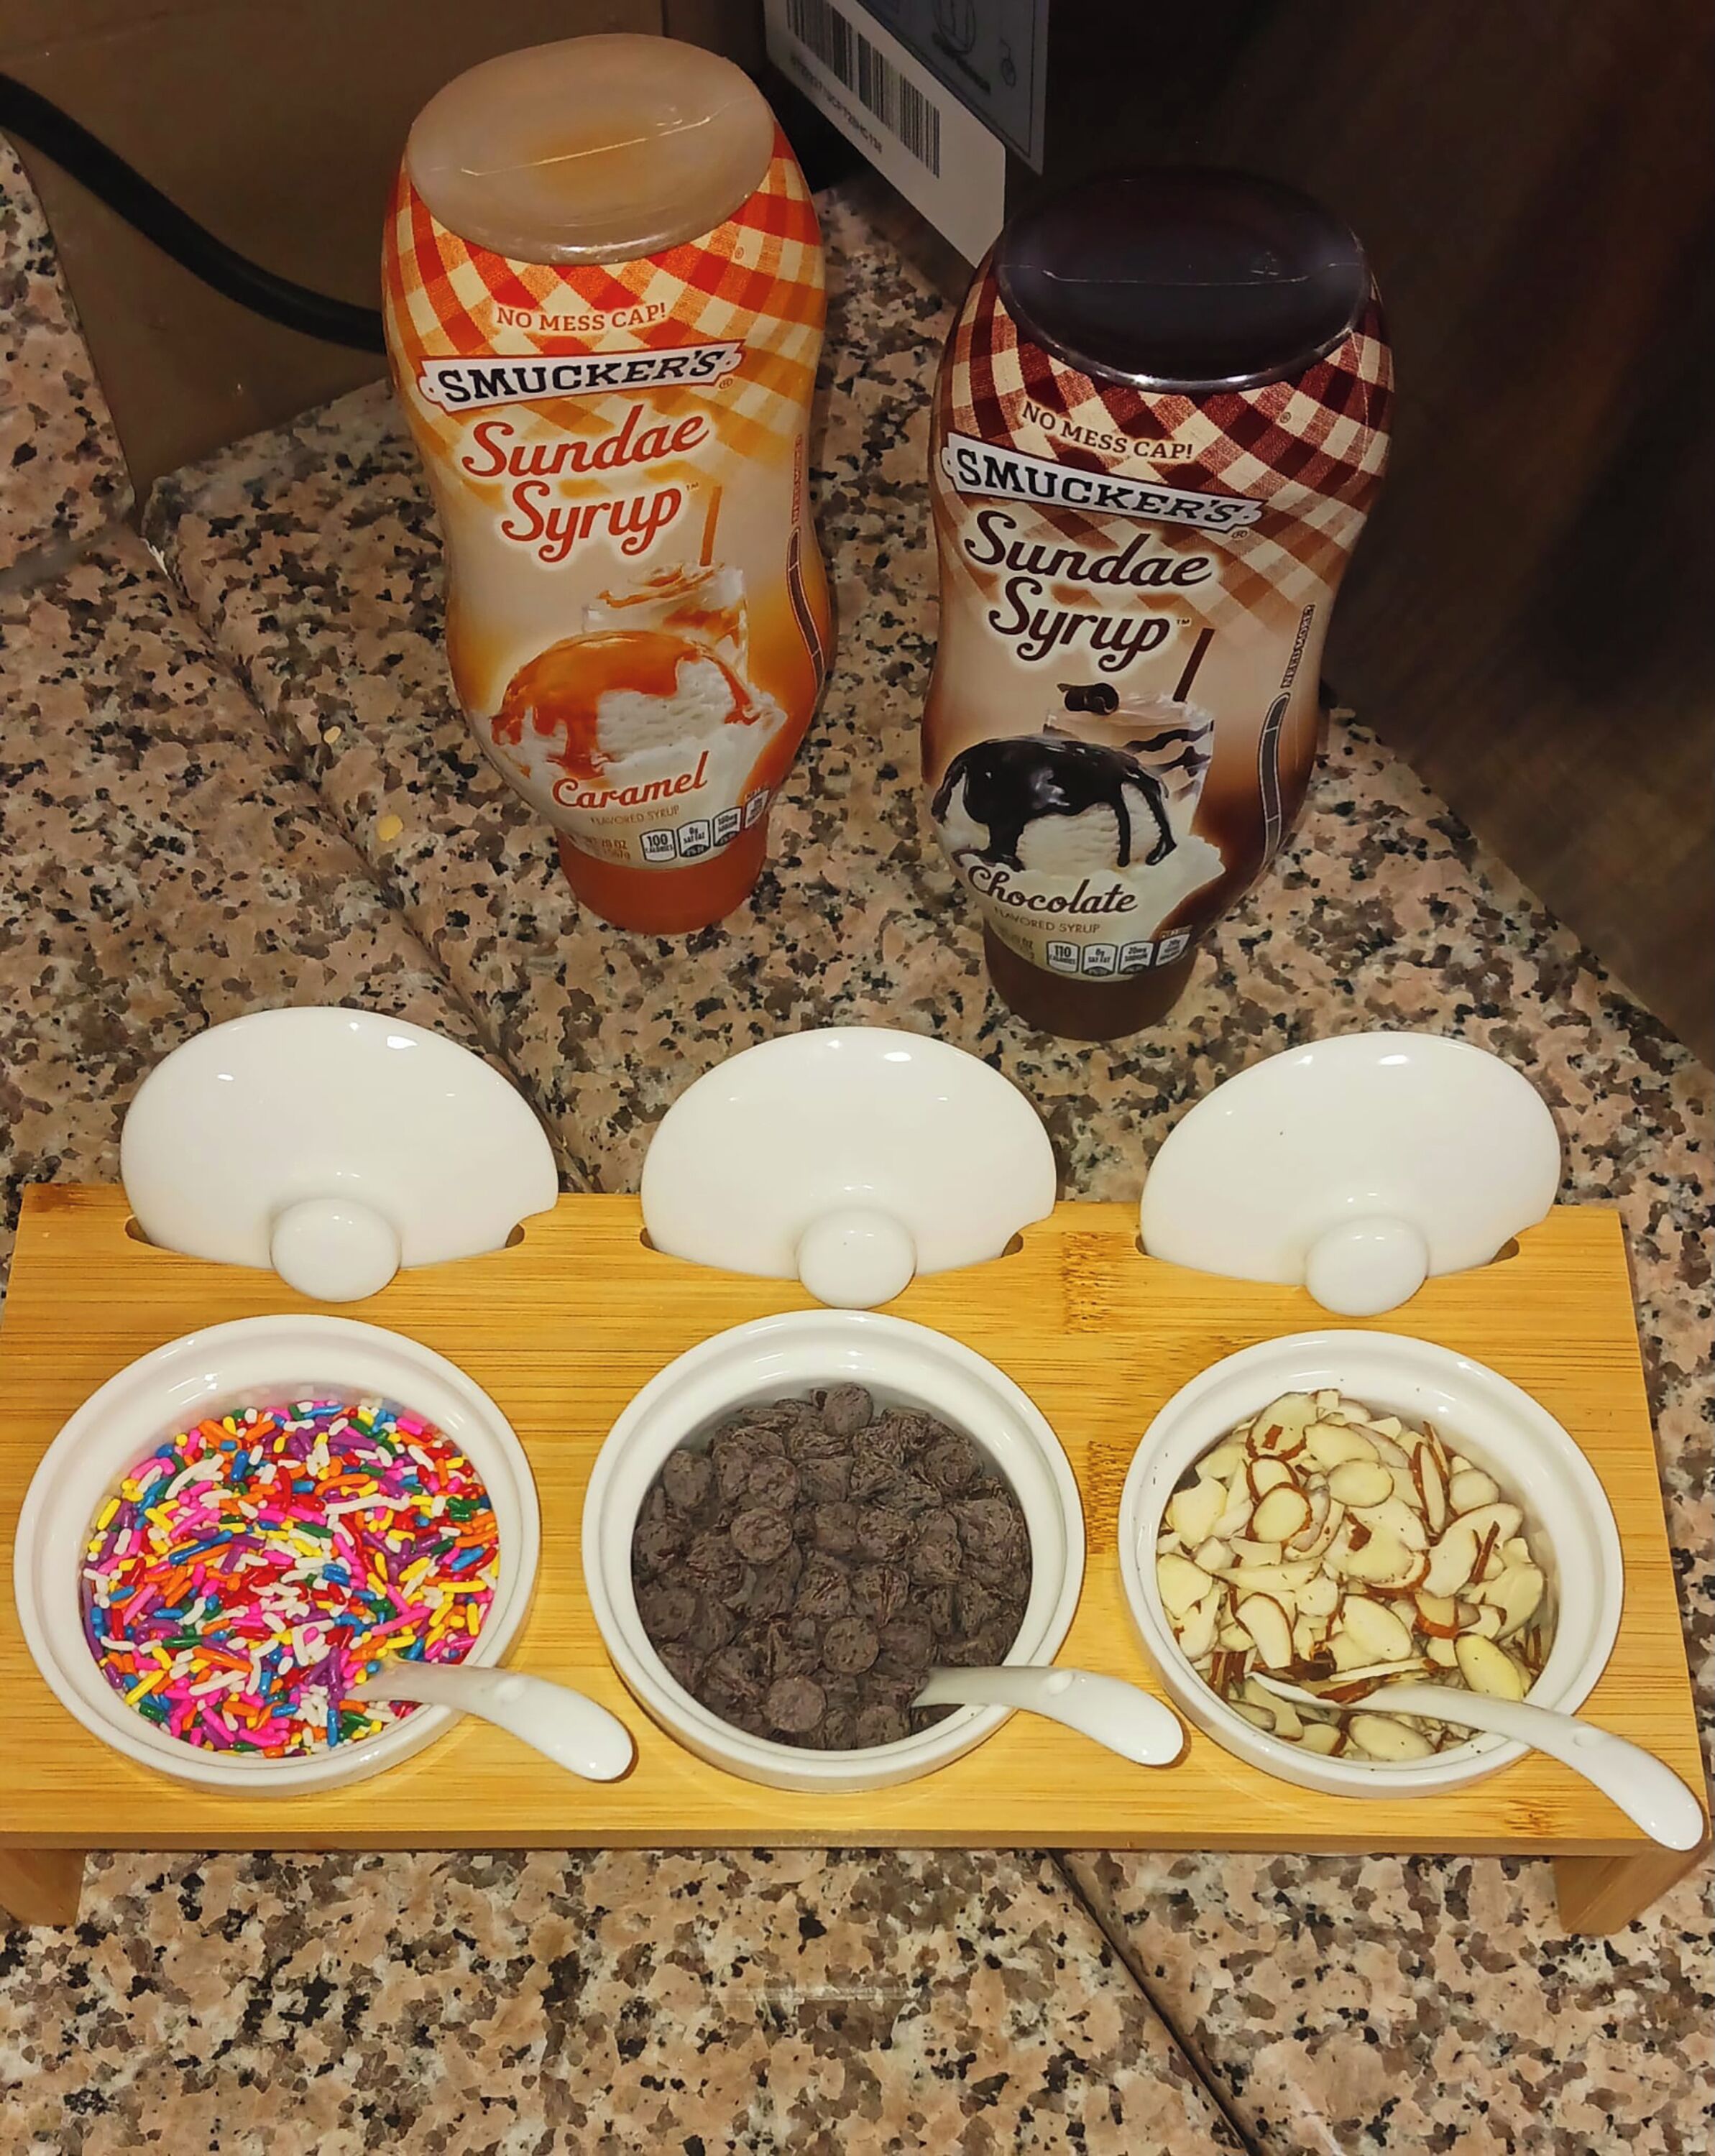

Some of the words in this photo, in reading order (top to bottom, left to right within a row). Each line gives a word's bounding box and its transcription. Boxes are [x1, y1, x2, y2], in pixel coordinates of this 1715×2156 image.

[496, 306, 533, 328] NO
[538, 311, 604, 332] MESS
[611, 303, 666, 328] CAP!
[438, 349, 727, 402] SMUCKER'S
[461, 405, 709, 477] Sundae
[1021, 402, 1057, 430] NO
[1059, 424, 1128, 454] MESS
[1133, 440, 1193, 460] CAP!
[957, 448, 1247, 523] SMUCKER'S
[500, 479, 683, 563] Syrup
[964, 510, 1213, 587] Sundae
[988, 576, 1171, 672] Syrup
[552, 750, 710, 809] Caramel
[647, 804, 680, 819] SYRUP
[647, 834, 668, 847] 100
[968, 865, 1138, 914] Chocolate
[993, 905, 1055, 931] FLAVORED
[1059, 922, 1100, 934] SYRUP
[1054, 946, 1072, 958] 110
